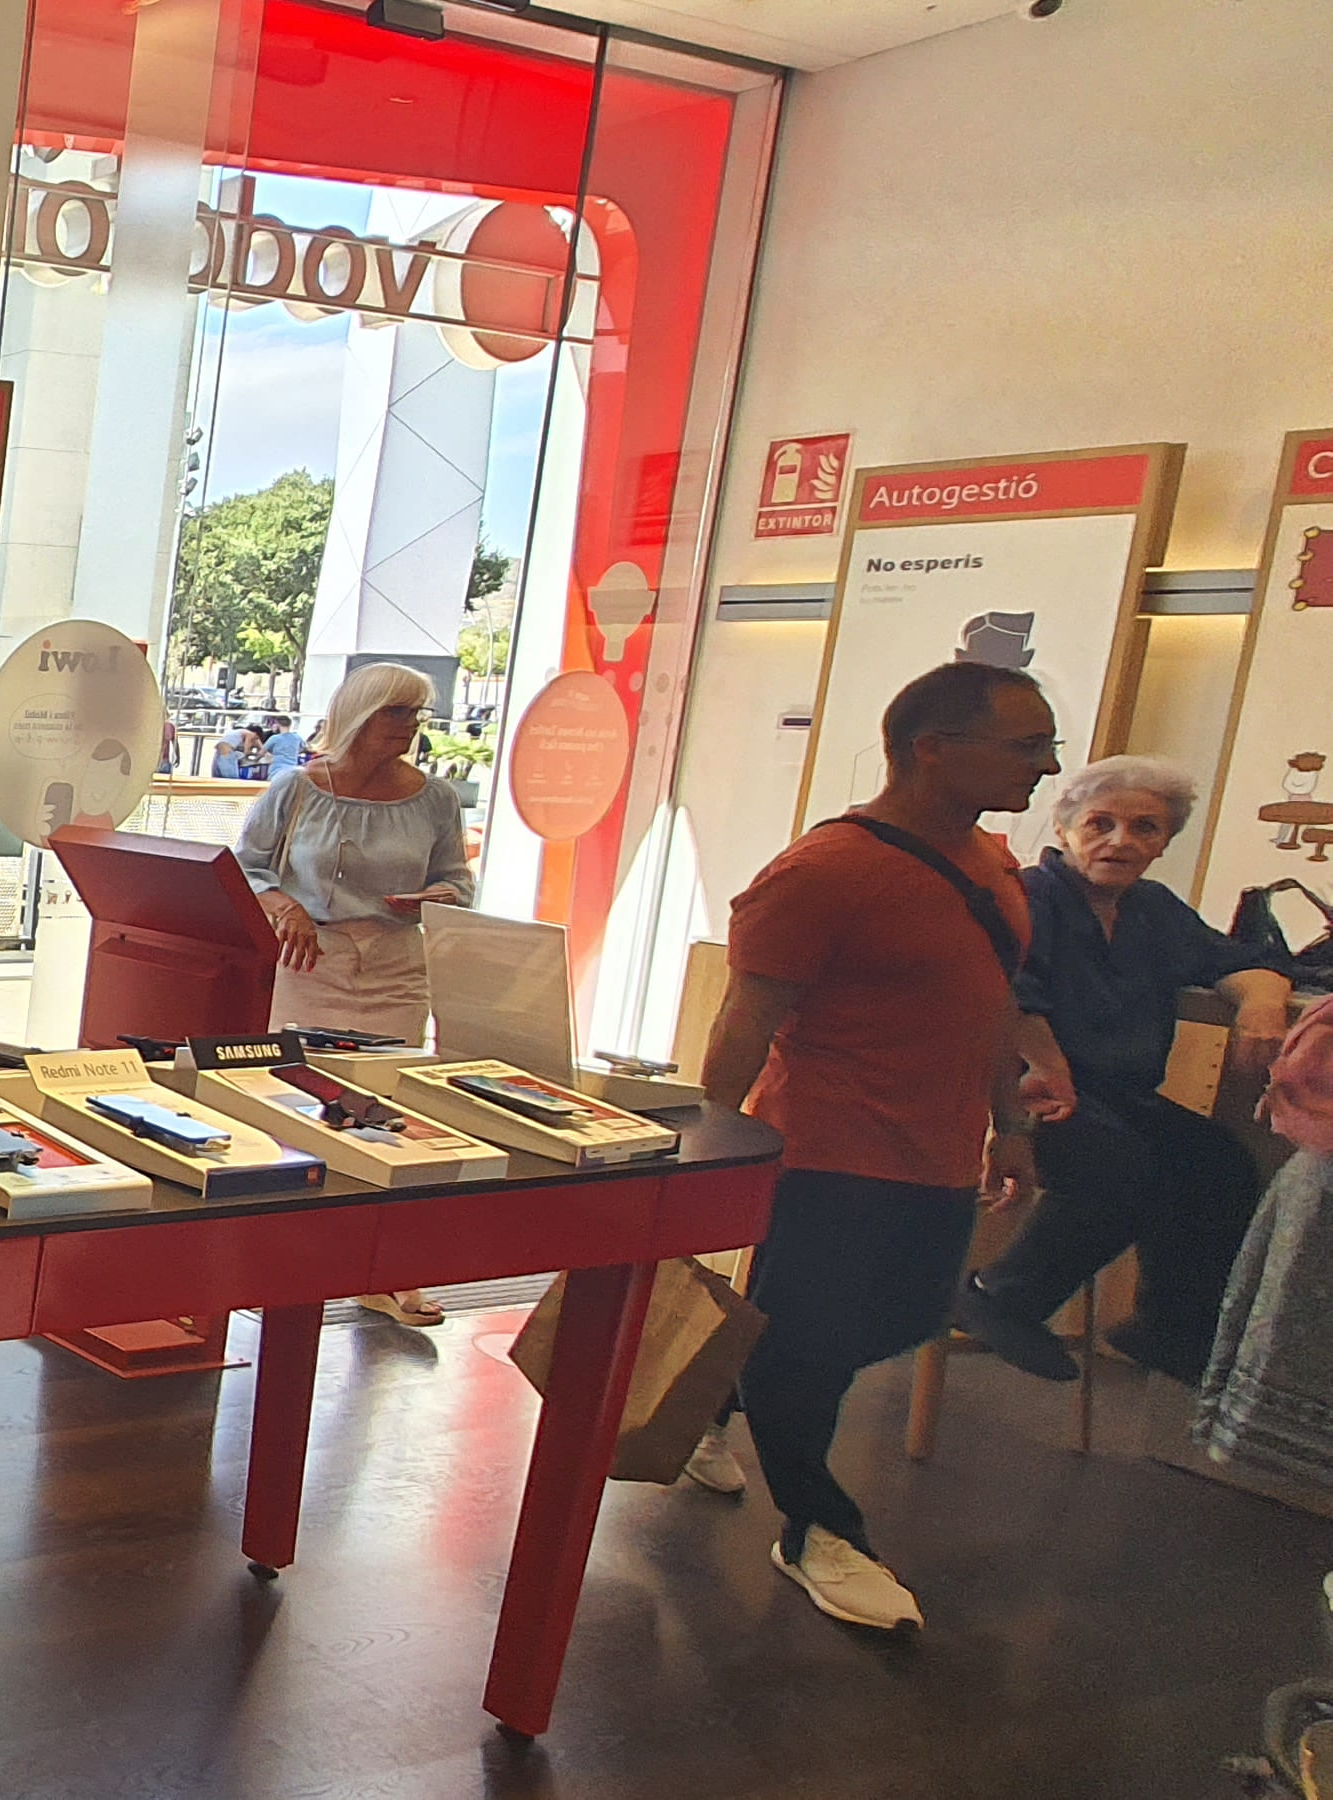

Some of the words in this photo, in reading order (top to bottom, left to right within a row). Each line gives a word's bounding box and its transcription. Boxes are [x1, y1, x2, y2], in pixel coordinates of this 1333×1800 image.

[869, 473, 1039, 510] Autogestió
[757, 514, 833, 530] EXTINTOR
[866, 557, 895, 573] No
[900, 553, 984, 574] esperis
[215, 1043, 282, 1061] SAMSUNG
[40, 1063, 81, 1080] Redmi
[84, 1062, 118, 1077] Note
[122, 1060, 138, 1075] 11
